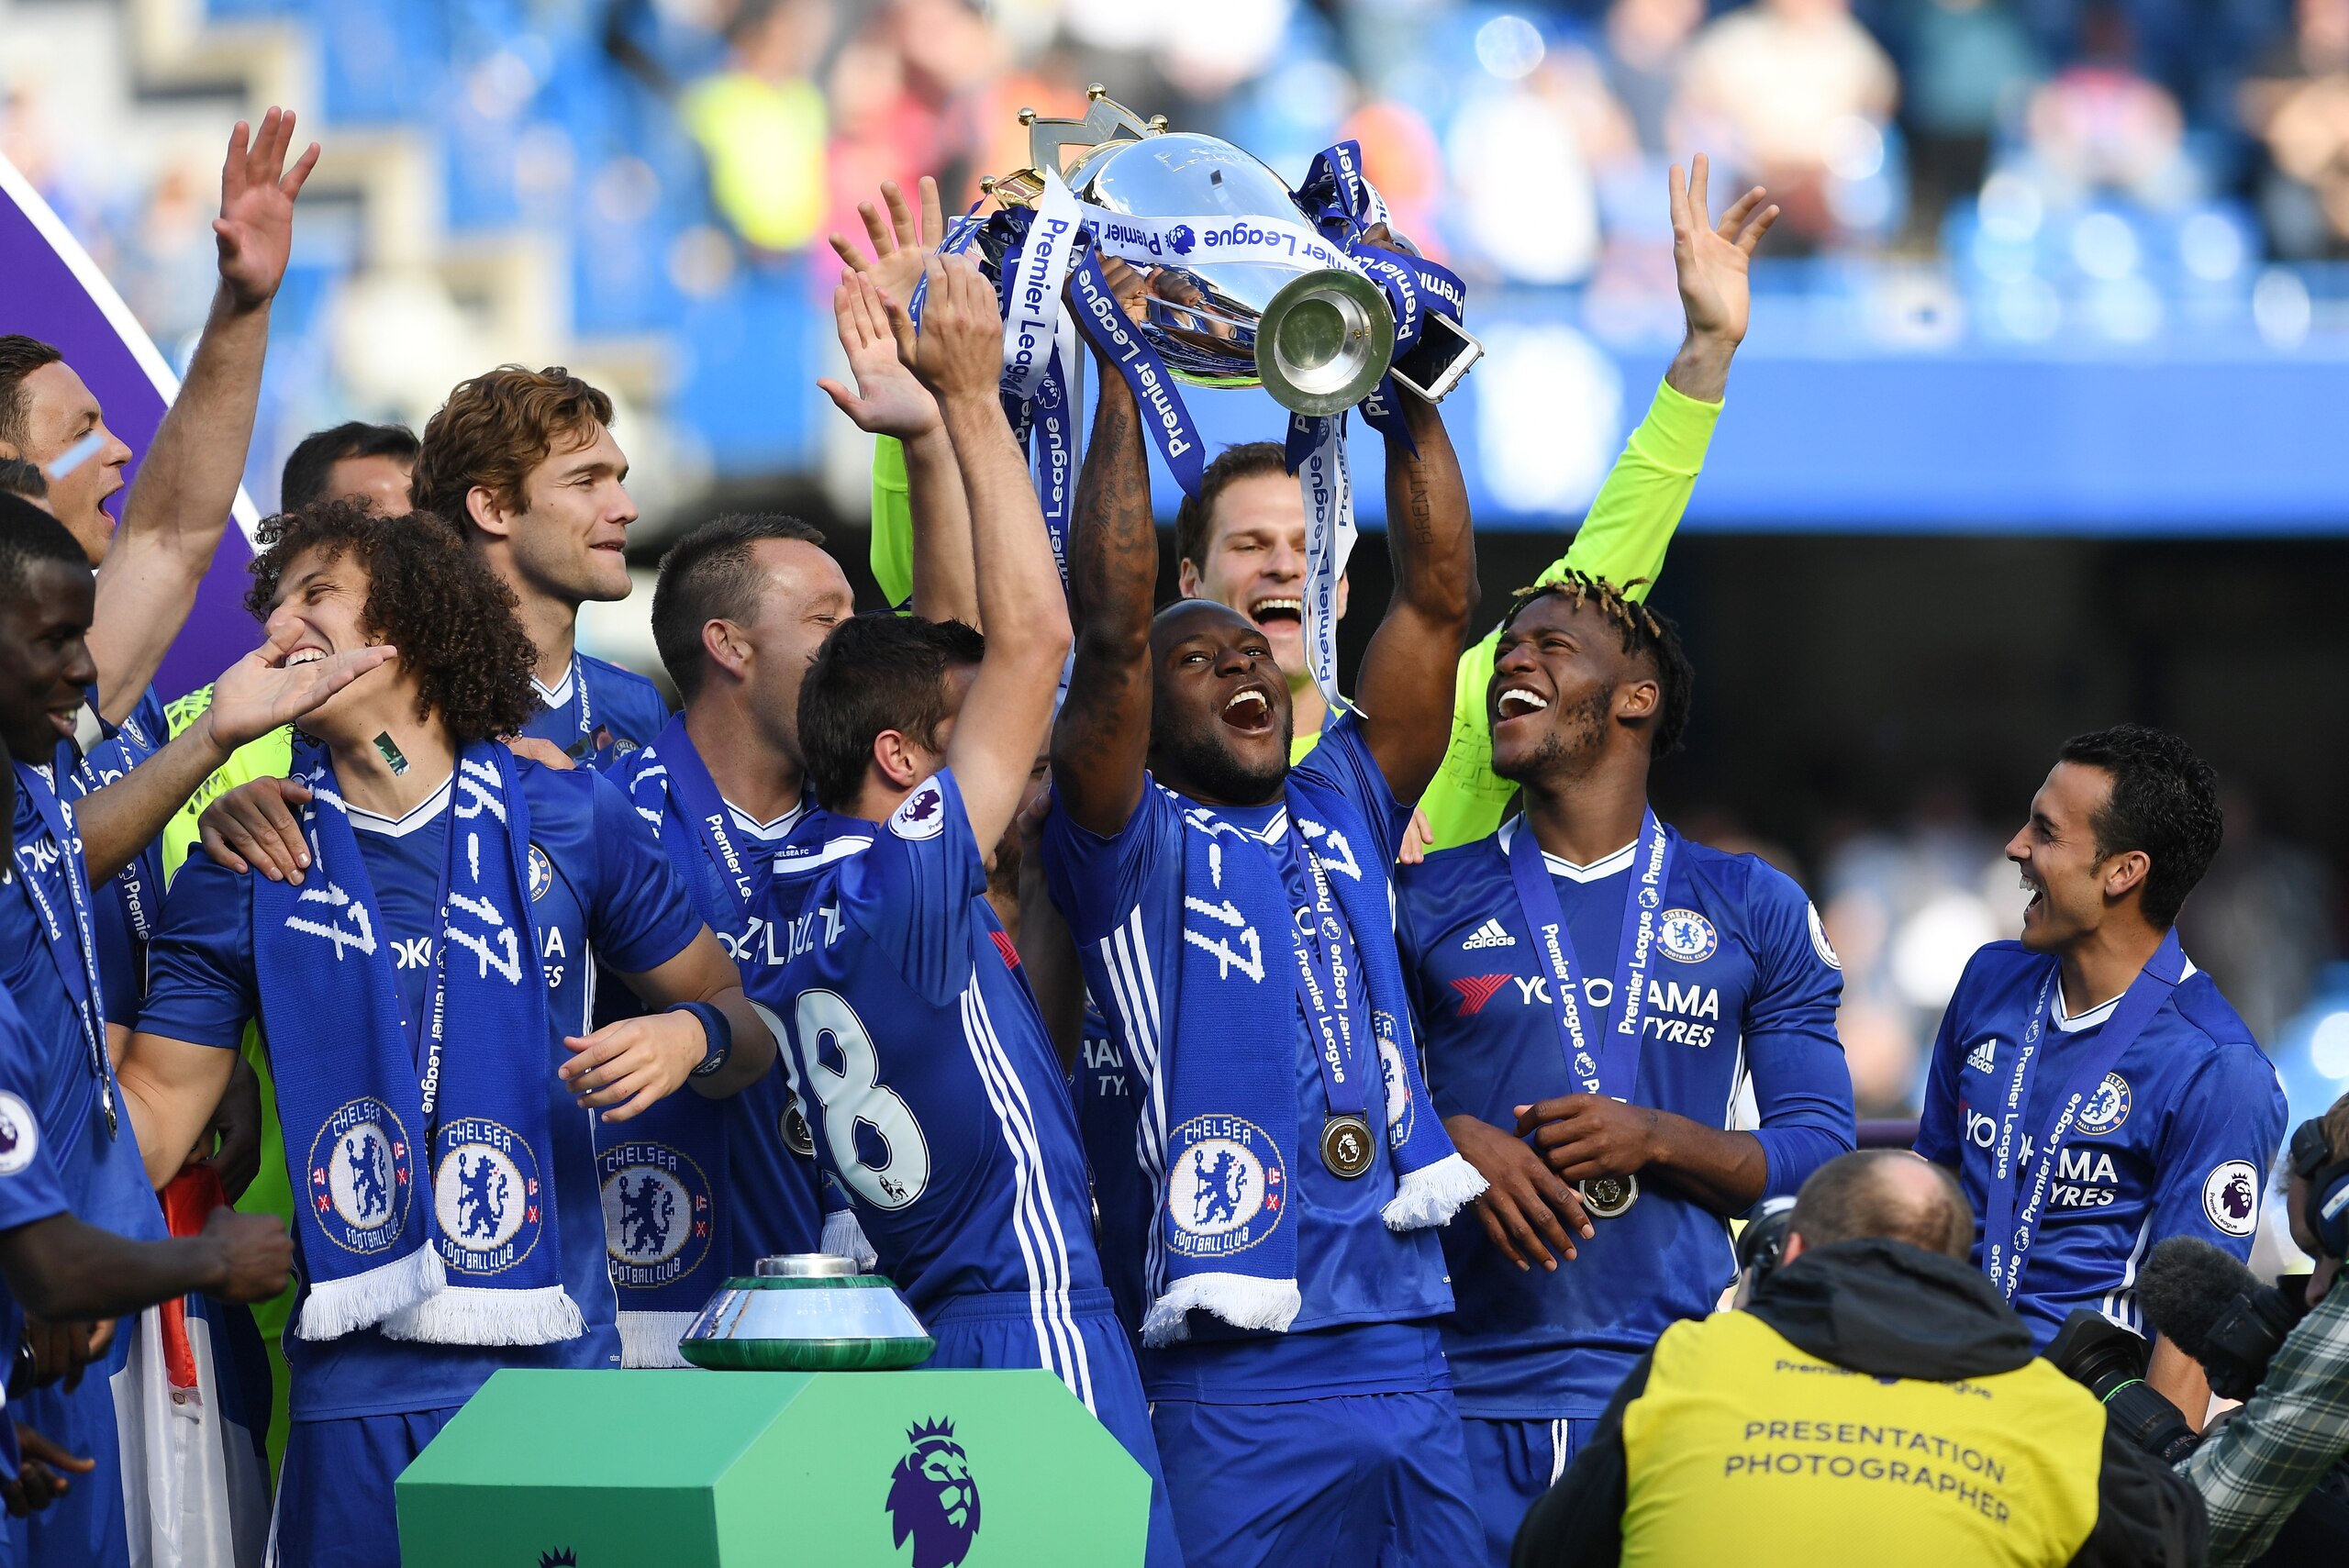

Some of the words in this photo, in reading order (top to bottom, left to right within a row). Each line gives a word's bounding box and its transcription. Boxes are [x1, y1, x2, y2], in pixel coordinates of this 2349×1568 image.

[1024, 218, 1070, 315] Premier
[1104, 223, 1163, 256] Premier
[1204, 222, 1297, 257] League
[1078, 269, 1141, 362] League
[1370, 261, 1417, 341] Premier
[1415, 270, 1464, 319] Premi
[1133, 361, 1192, 459] Premier
[1046, 417, 1068, 517] League
[1335, 431, 1349, 527] Premier
[1309, 455, 1329, 555] League
[1318, 583, 1330, 682] Premier
[705, 813, 744, 874] Premier
[1641, 833, 1666, 884] Premier
[61, 840, 83, 907] Premier
[79, 911, 96, 982] League
[124, 881, 150, 940] Premie
[1308, 851, 1333, 913] Premier
[1462, 935, 1517, 951] adidas
[1628, 911, 1655, 969] League
[1662, 911, 1704, 926] CHELSEA
[1330, 943, 1348, 1010] League
[1664, 948, 1693, 961] FOOTBALL
[1513, 974, 1719, 1022] YOOAMA
[1541, 923, 1570, 982] Premier
[1559, 984, 1586, 1049] League
[1617, 970, 1644, 1035] Premier
[1294, 949, 1326, 1013] Premier
[1318, 1016, 1345, 1084] League
[1642, 1017, 1716, 1050] TYRES
[420, 1046, 443, 1114] League
[1966, 1054, 1995, 1074] adidas
[2007, 1046, 2035, 1109] Premier
[2104, 1074, 2128, 1097] ELSEA
[333, 1102, 382, 1138] CHELSEA
[448, 1123, 512, 1153] CHELSEA
[1184, 1119, 1252, 1145] CHELSEA
[1997, 1113, 2019, 1180] League
[607, 1147, 677, 1172] CHELSEA
[2021, 1157, 2052, 1224] Premier
[2043, 1093, 2083, 1156] League
[2050, 1183, 2117, 1207] YRES
[2209, 1192, 2219, 1216] Premier
[2217, 1214, 2238, 1229] League
[345, 1227, 386, 1251] FOOTBALL
[385, 1211, 400, 1241] CLUB
[442, 1239, 489, 1271] FOOTBALL
[489, 1243, 514, 1267] CLUB
[1174, 1229, 1221, 1252] FOOTBALL
[1223, 1226, 1250, 1250] CLUB
[610, 1260, 654, 1284] OOTBALL
[656, 1257, 681, 1281] CLUB
[1744, 1420, 2006, 1485] PRESENTATION
[1724, 1452, 2010, 1526] PHOTOGRAPHER
